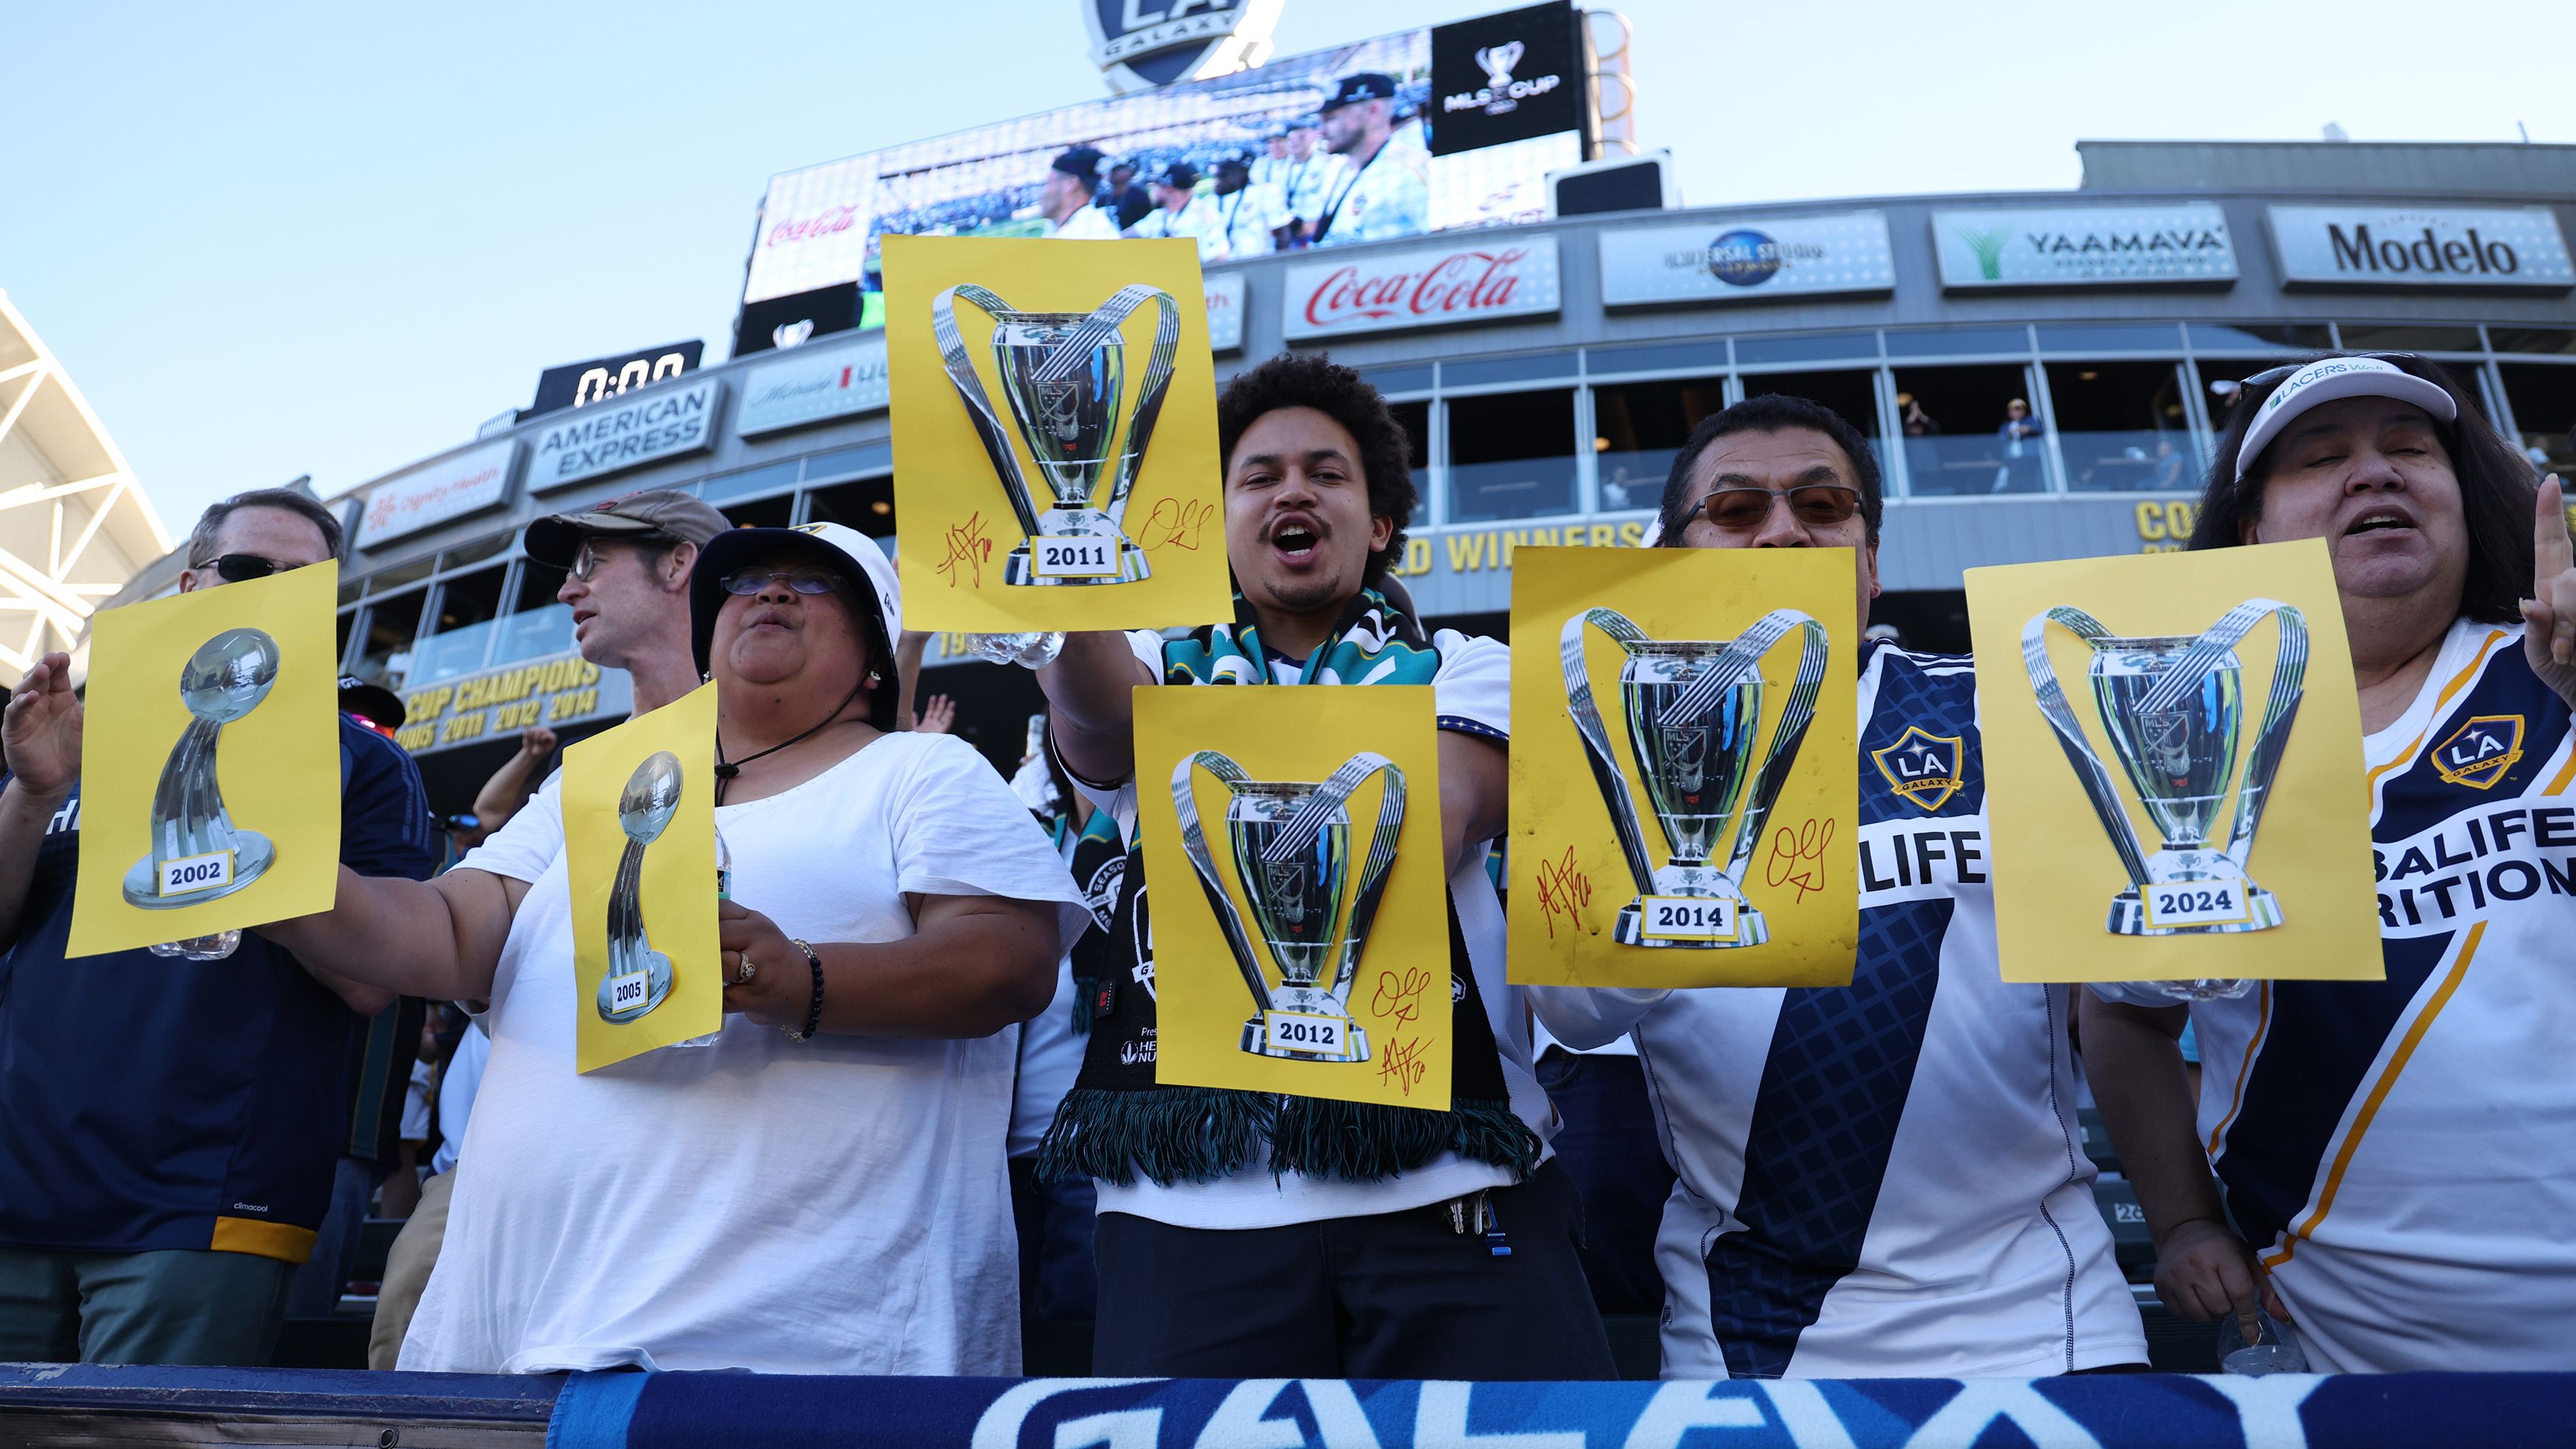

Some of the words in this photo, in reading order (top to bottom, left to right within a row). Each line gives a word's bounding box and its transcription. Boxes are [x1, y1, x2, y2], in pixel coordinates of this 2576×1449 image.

[1105, 13, 1236, 55] GALAXY
[1444, 88, 1493, 113] MLS
[1509, 74, 1560, 99] CUP
[2327, 223, 2518, 274] Modelo
[2282, 364, 2347, 398] LACERS
[540, 387, 706, 454] AMERICAN
[558, 416, 701, 477] EXPRESS
[1046, 546, 1105, 566] 2011
[406, 686, 453, 726] CUP
[453, 656, 601, 713] CHAMPIONS
[494, 700, 542, 731] 2012
[548, 688, 598, 721] 2014
[2145, 718, 2170, 728] MLS
[1666, 731, 1689, 742] MLS
[2451, 735, 2505, 765] LA
[1898, 753, 1948, 777] LA
[2453, 755, 2508, 776] GALAXY
[1902, 779, 1952, 790] GALAXY
[170, 861, 222, 885] 2002
[1858, 831, 1986, 894] LIFE
[1094, 861, 1127, 892] SEASO
[2159, 890, 2232, 914] 2024
[1658, 906, 1724, 928] 2014
[616, 981, 642, 1003] 2005
[1279, 1022, 1335, 1045] 2012
[233, 1202, 269, 1212] climacool
[972, 1376, 2327, 1449] GALAXY
